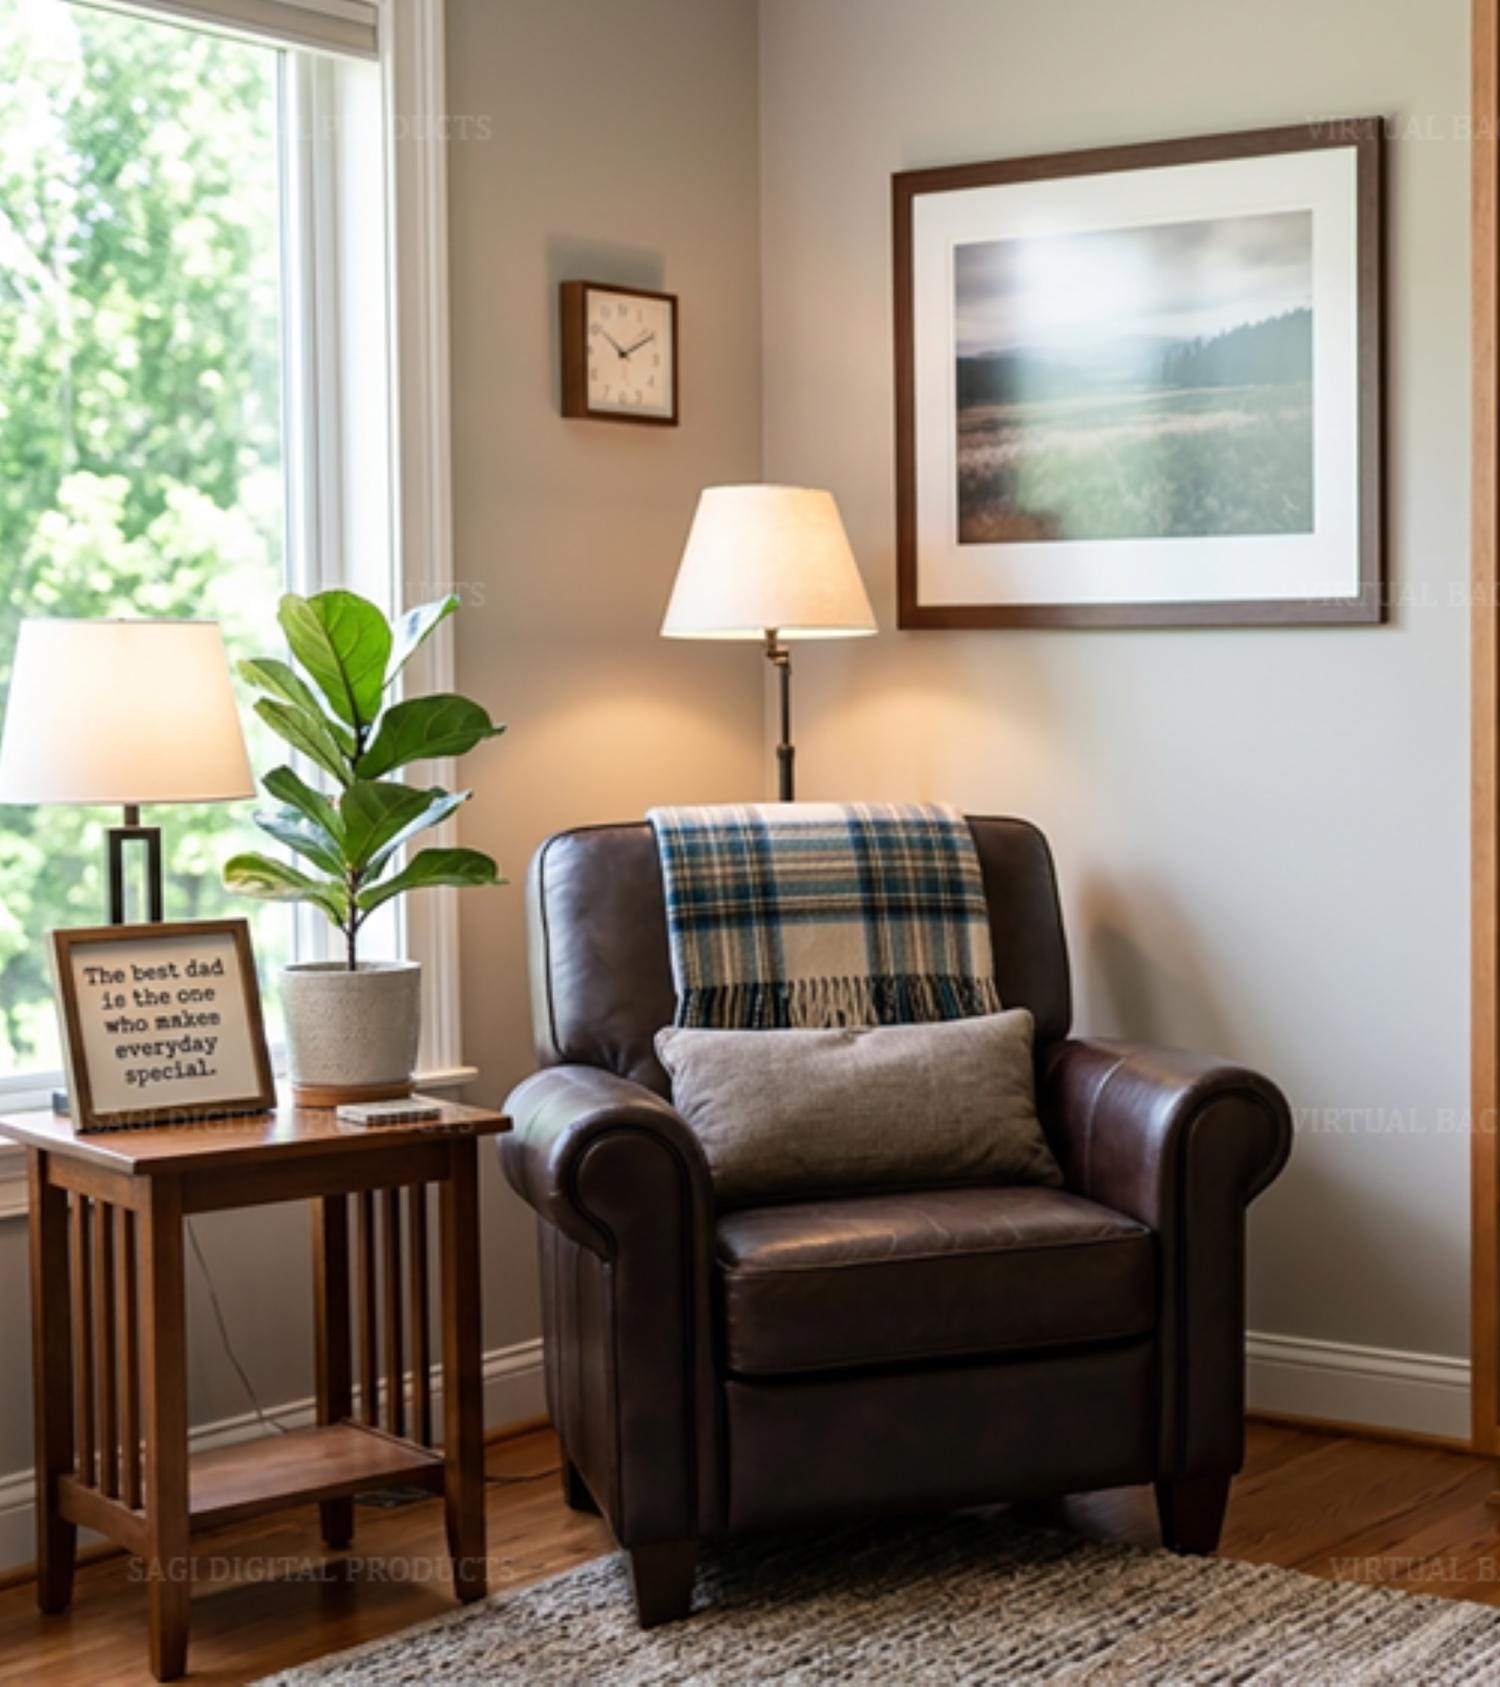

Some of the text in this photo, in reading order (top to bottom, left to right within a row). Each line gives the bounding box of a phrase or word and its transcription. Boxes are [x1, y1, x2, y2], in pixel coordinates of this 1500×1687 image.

[83, 957, 225, 986] The best dad
[132, 988, 170, 1007] the
[176, 988, 215, 1004] one
[104, 1015, 149, 1034] who
[114, 1033, 219, 1059] everyday
[124, 1058, 218, 1088] special.
